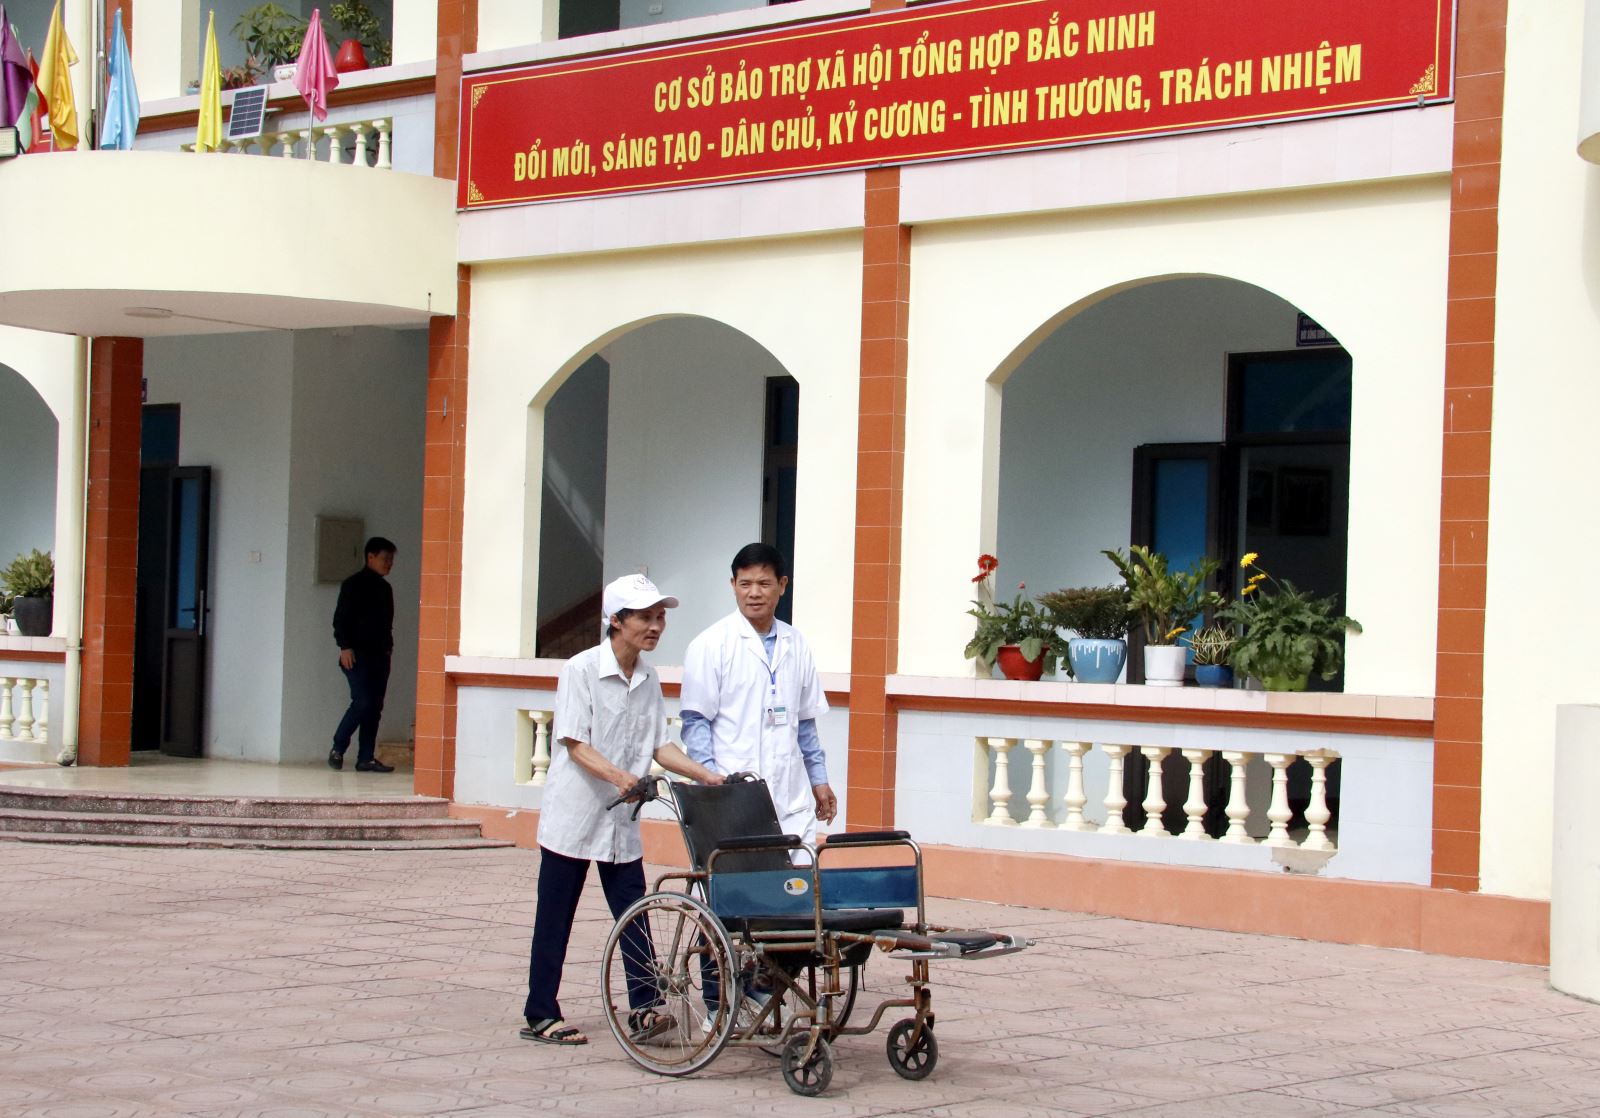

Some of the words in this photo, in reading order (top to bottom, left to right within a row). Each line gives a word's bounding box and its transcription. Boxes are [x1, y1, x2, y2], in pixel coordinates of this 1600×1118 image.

[514, 138, 546, 181] ĐỔI
[552, 139, 596, 177] MỚI,
[602, 133, 656, 172] SÁNG
[663, 131, 701, 170] TẠO
[721, 118, 765, 158] DÂN
[771, 106, 821, 151] CHỦ,
[829, 100, 858, 145] KỶ
[864, 100, 945, 141] CƯƠNG
[969, 87, 1027, 129] TÌNH
[1035, 75, 1150, 120] THƯƠNG,
[1160, 58, 1252, 105] TRÁCH
[1261, 41, 1361, 94] NHIỆM
[654, 76, 682, 112] CƠ
[687, 65, 715, 108] SỞ
[720, 60, 763, 104] BẢO
[769, 57, 811, 101] TRỢ
[816, 49, 846, 91] XÃ
[852, 44, 892, 90] HỘI
[899, 31, 962, 79] TỔNG
[970, 29, 1020, 74] HỢP
[1027, 12, 1079, 62] BẮC
[1087, 11, 1155, 54] NINH
